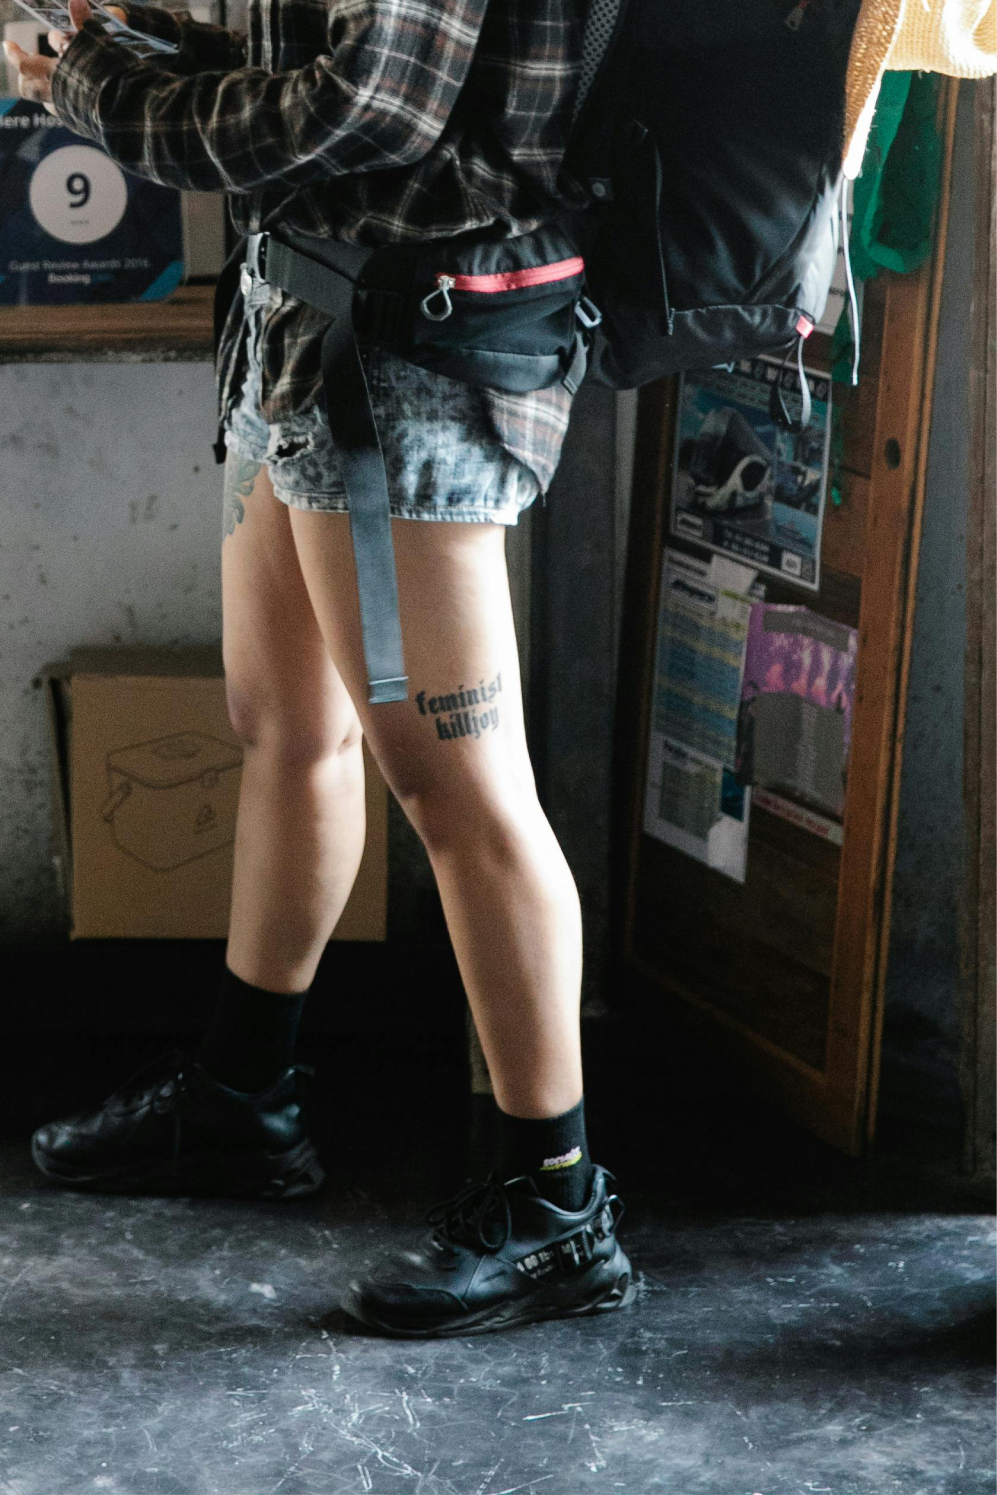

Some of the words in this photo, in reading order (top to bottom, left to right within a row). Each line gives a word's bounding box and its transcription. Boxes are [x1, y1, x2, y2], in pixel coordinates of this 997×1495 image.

[65, 171, 92, 209] 9
[8, 259, 41, 273] Guest
[82, 257, 122, 271] Awards
[415, 671, 503, 716] feminist
[435, 706, 500, 741] killjoy
